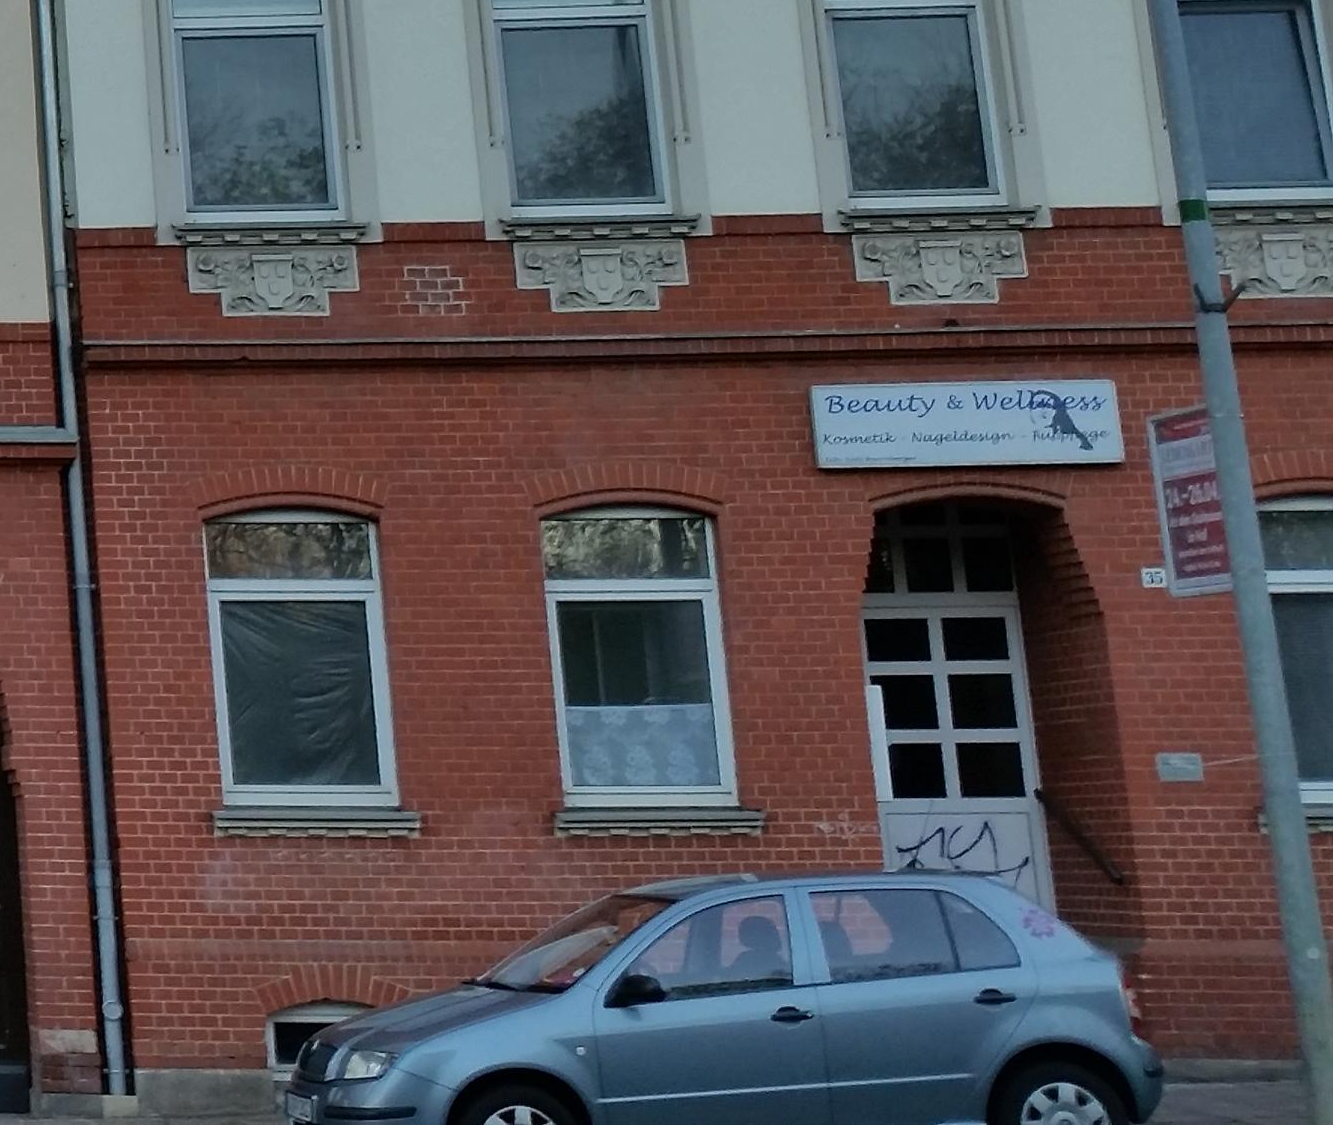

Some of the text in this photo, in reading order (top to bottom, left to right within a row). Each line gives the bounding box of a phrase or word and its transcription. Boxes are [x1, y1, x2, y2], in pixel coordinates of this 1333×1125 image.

[824, 394, 935, 418] Beauty
[946, 395, 964, 410] &
[822, 432, 897, 445] Kosmetik
[911, 430, 1014, 446] Nageldesign
[1144, 570, 1164, 584] 35
